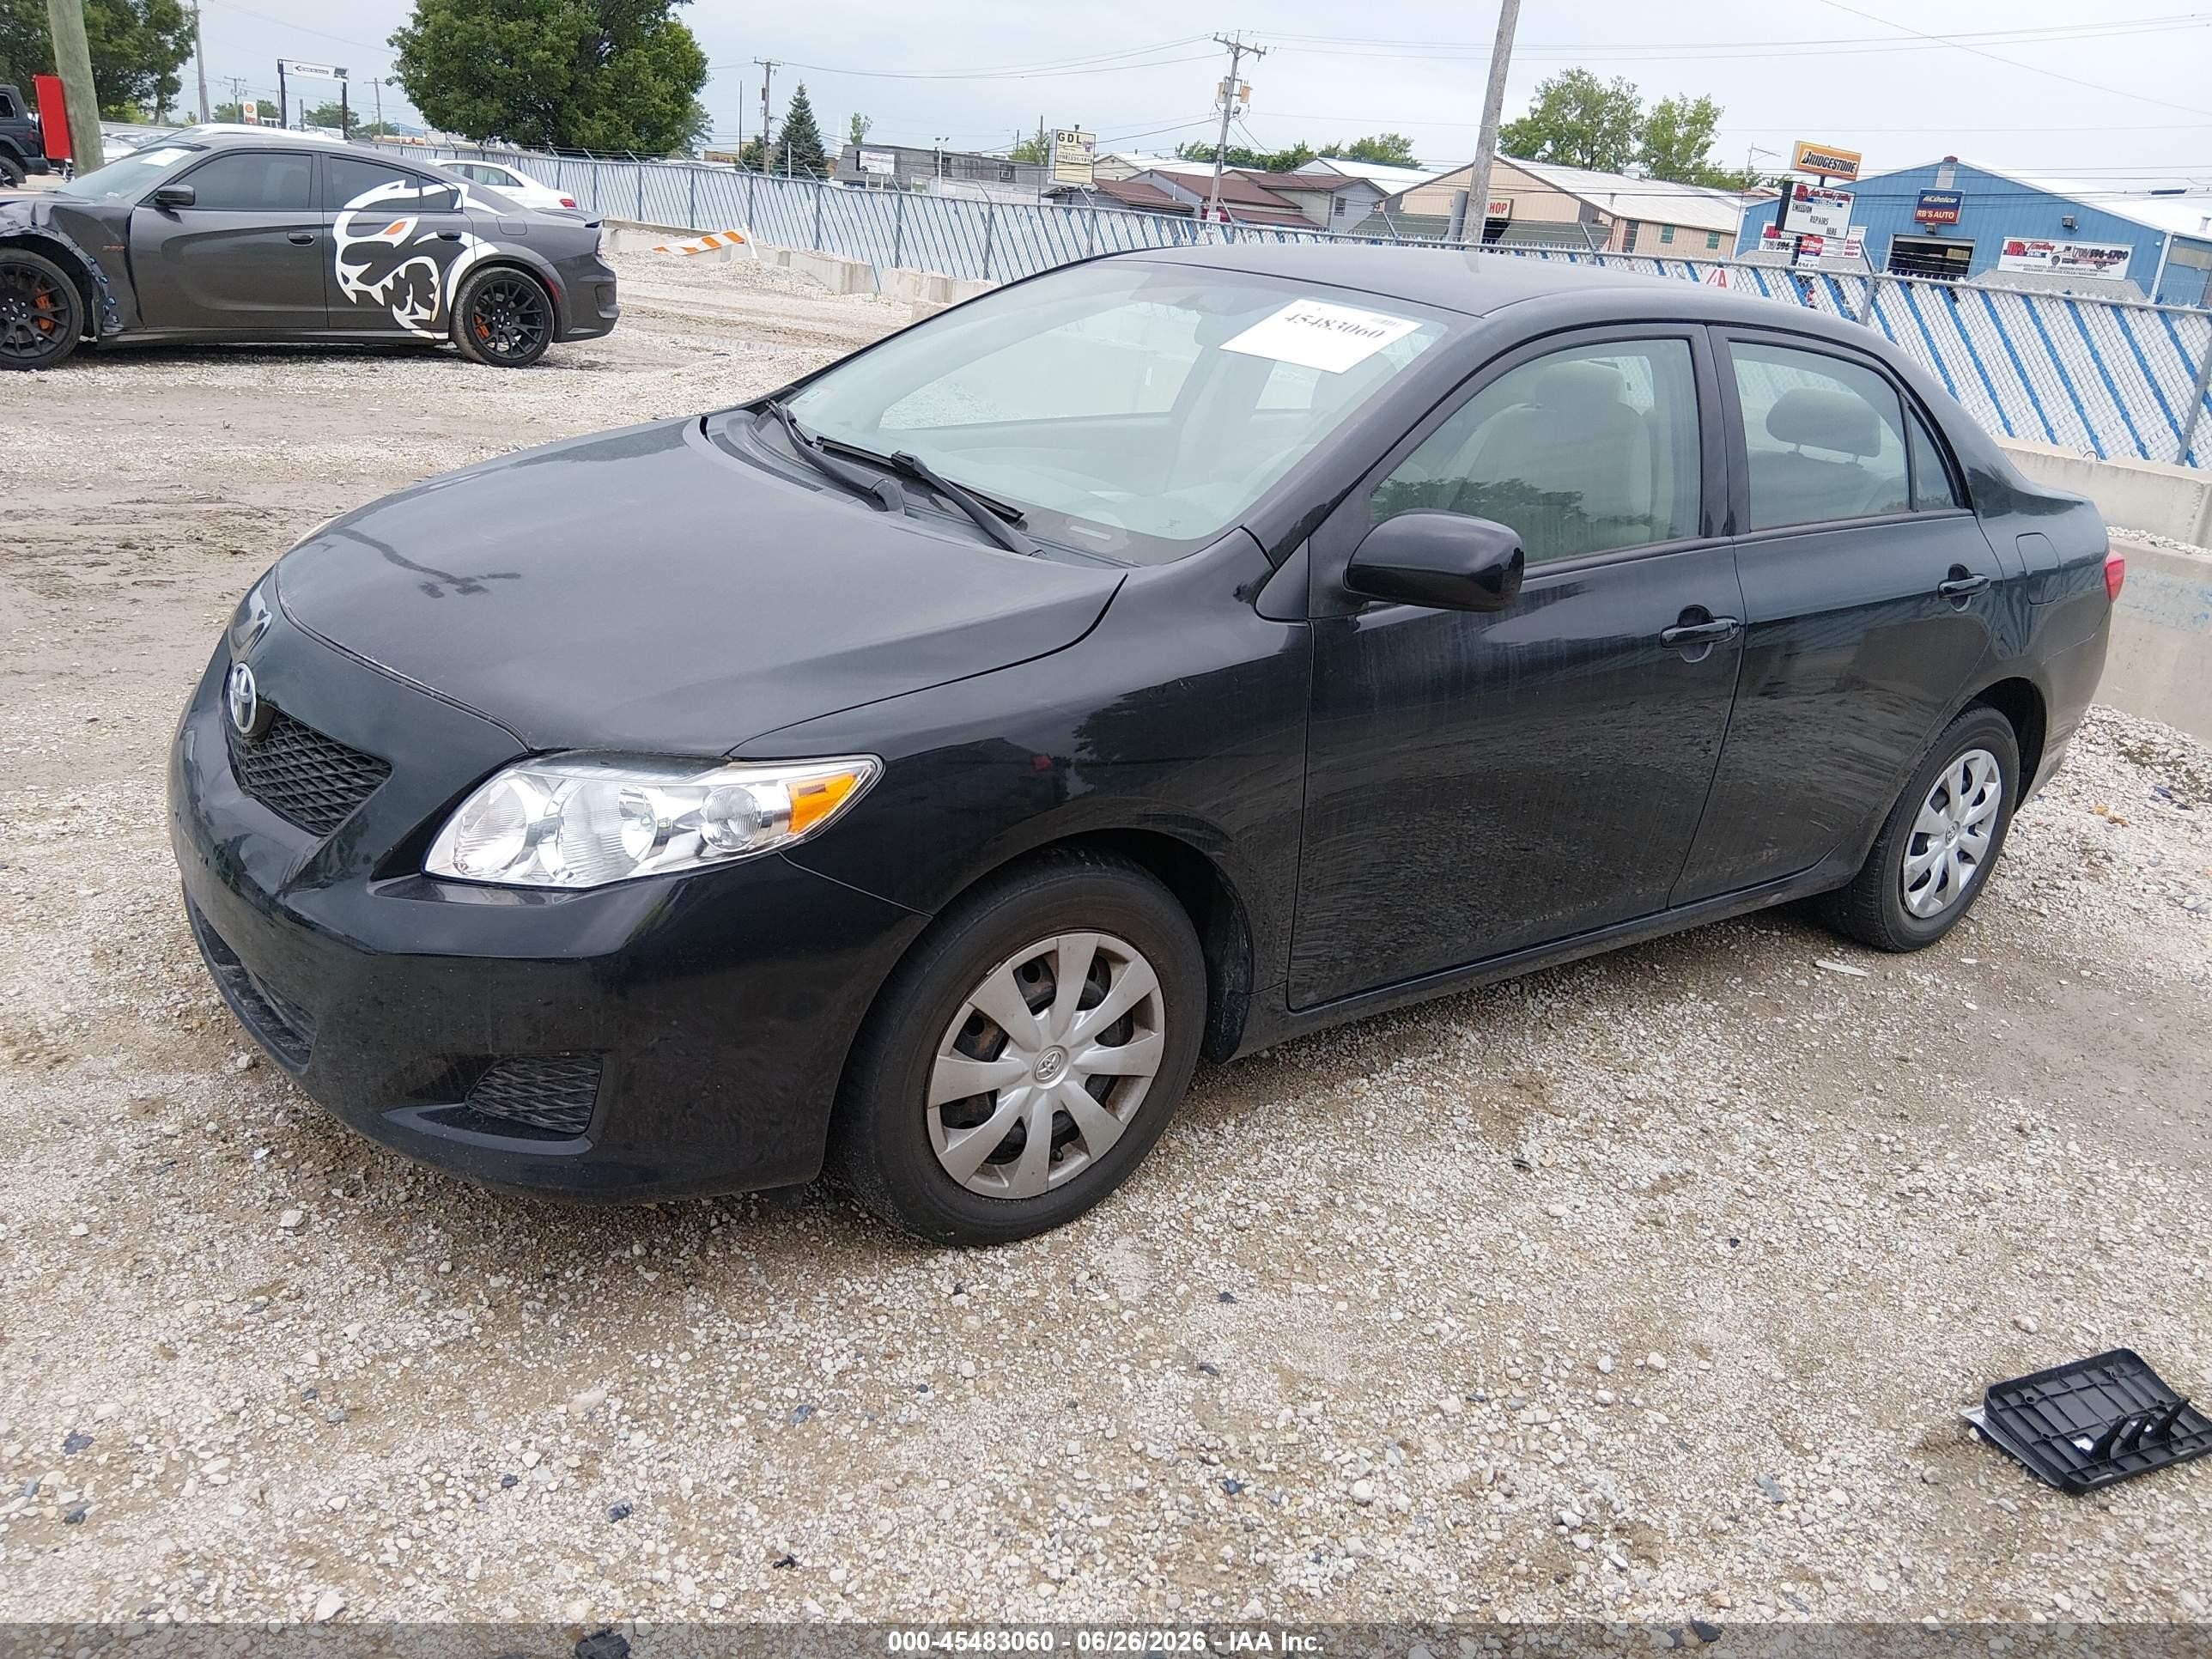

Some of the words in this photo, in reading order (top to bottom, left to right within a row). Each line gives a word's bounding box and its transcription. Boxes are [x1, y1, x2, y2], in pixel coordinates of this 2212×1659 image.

[1057, 132, 1082, 144] GDL
[1801, 150, 1856, 173] BRIDGESTONE
[1791, 204, 1813, 214] EMISSION
[1917, 210, 1933, 218] RB'S
[1809, 215, 1829, 226] REPAIRS
[1826, 227, 1838, 236] HERE
[1284, 313, 1386, 338] 45483060
